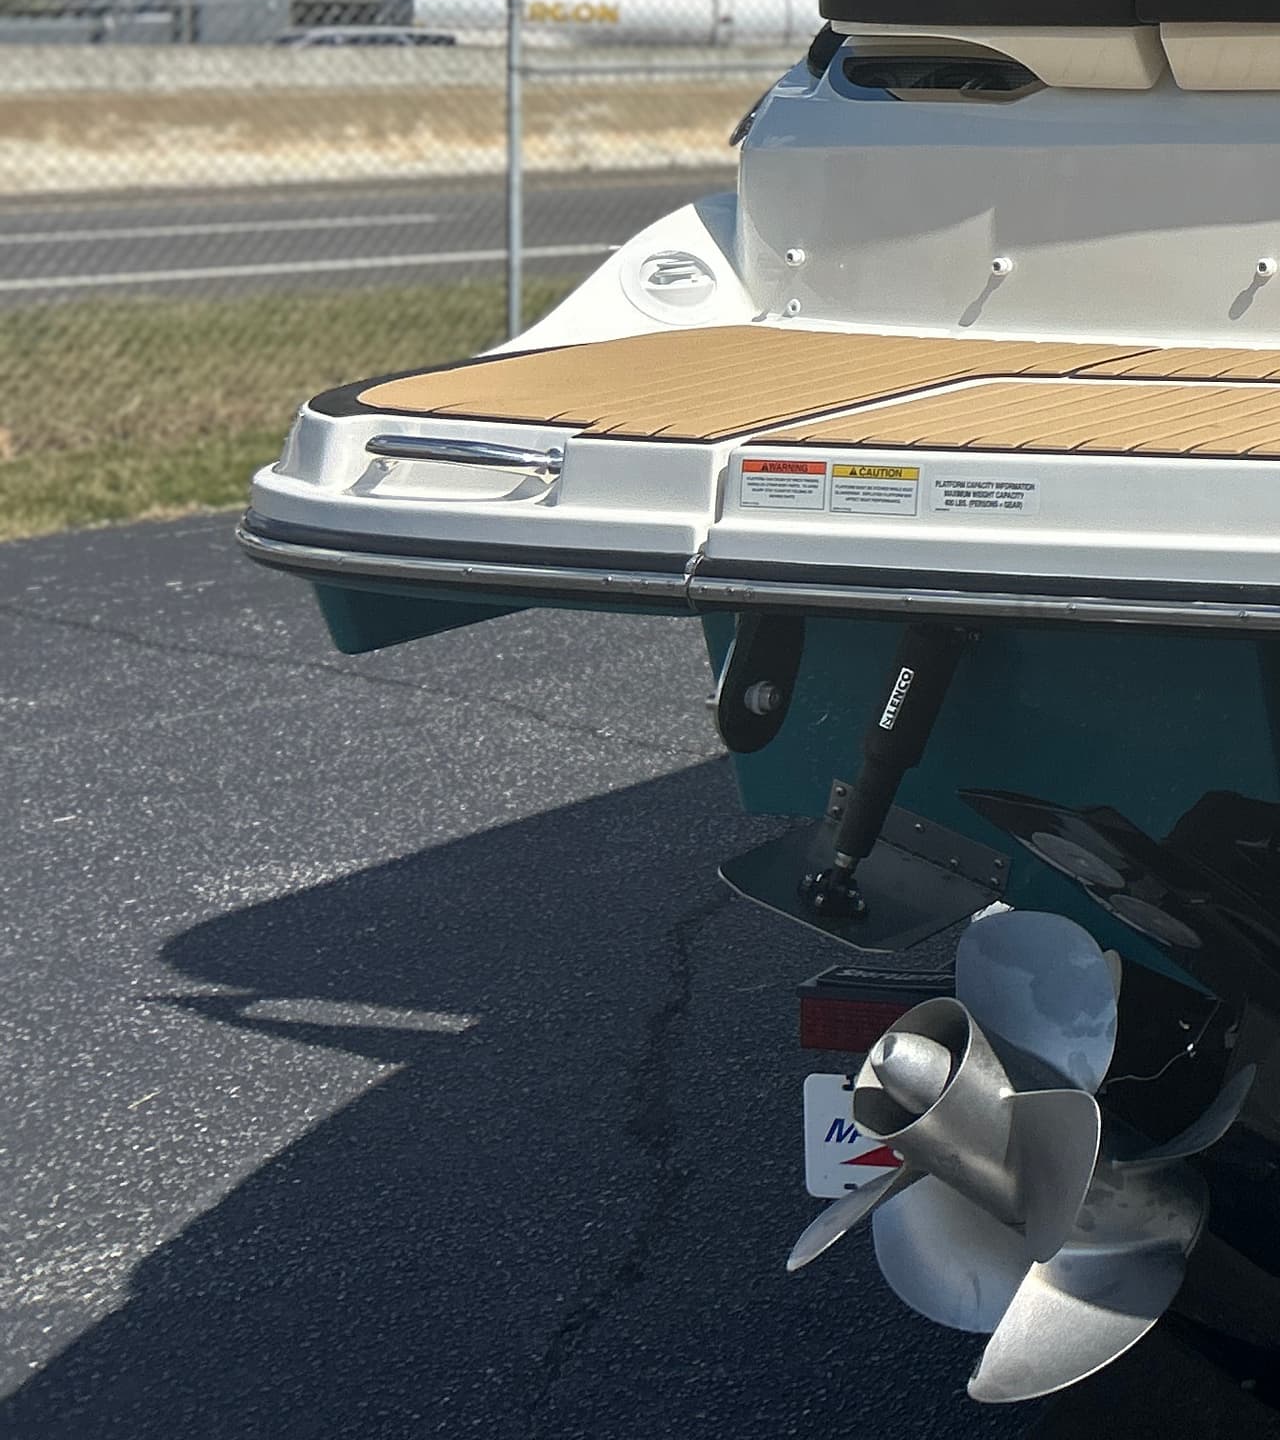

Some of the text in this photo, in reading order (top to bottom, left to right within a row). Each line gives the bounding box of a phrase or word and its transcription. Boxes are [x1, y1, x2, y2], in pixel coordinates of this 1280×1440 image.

[768, 462, 808, 472] WARNING
[859, 467, 903, 478] CAUTION
[885, 669, 913, 716] LENCO
